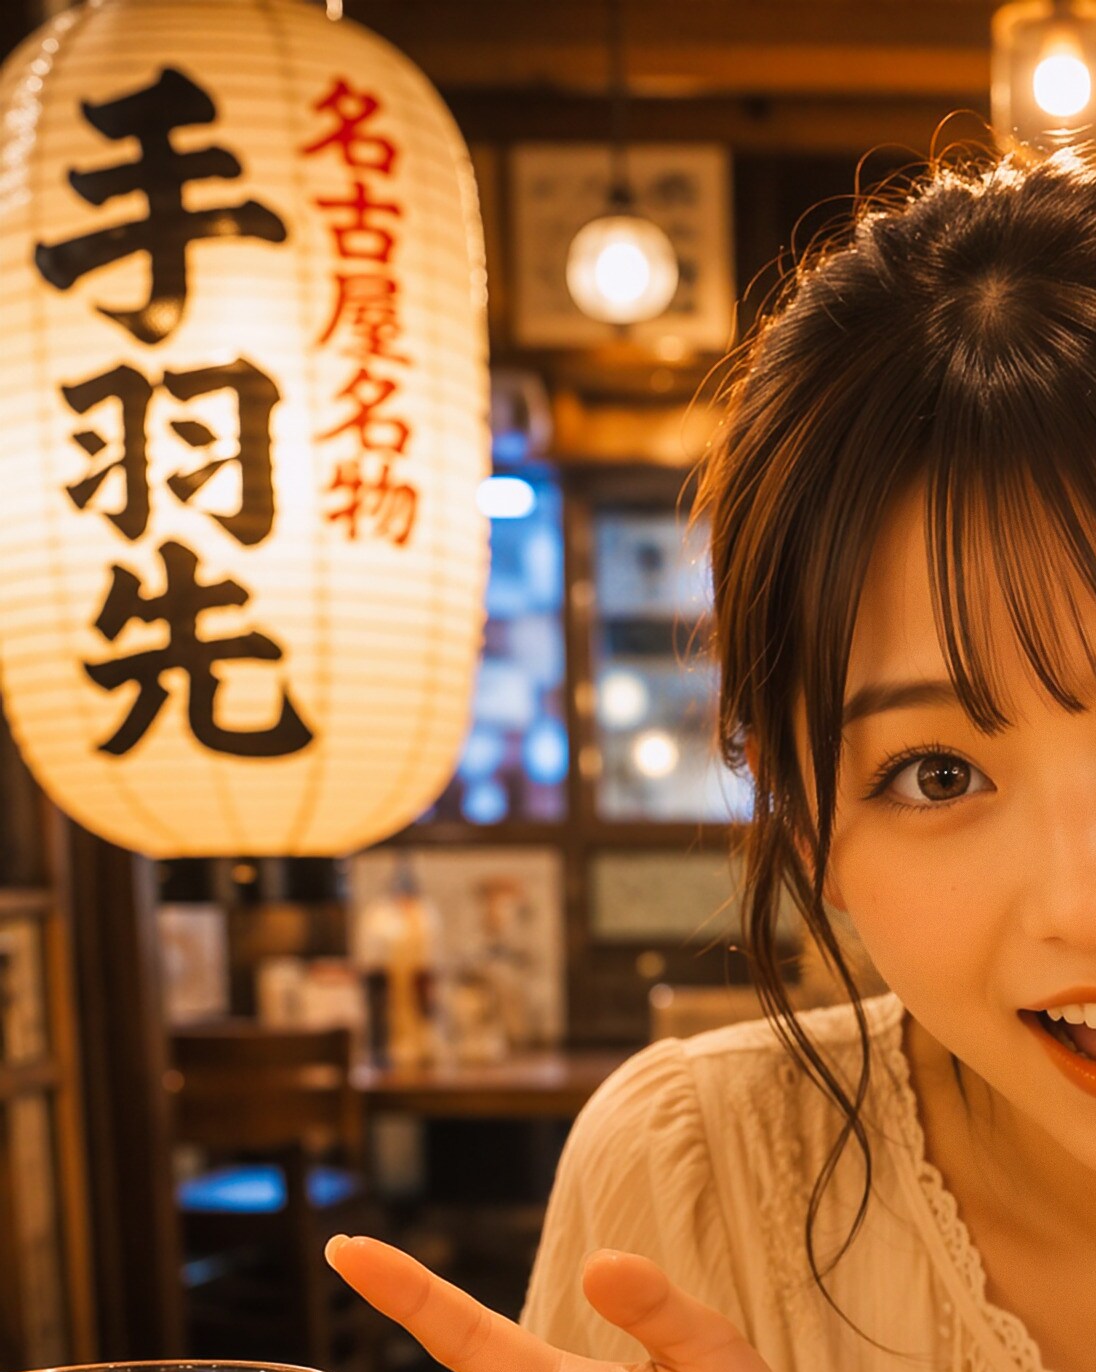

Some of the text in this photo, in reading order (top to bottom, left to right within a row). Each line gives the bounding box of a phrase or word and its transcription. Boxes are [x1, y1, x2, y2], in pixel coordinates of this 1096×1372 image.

[34, 65, 315, 760] 手羽先
[302, 78, 418, 549] 名古屋名物
